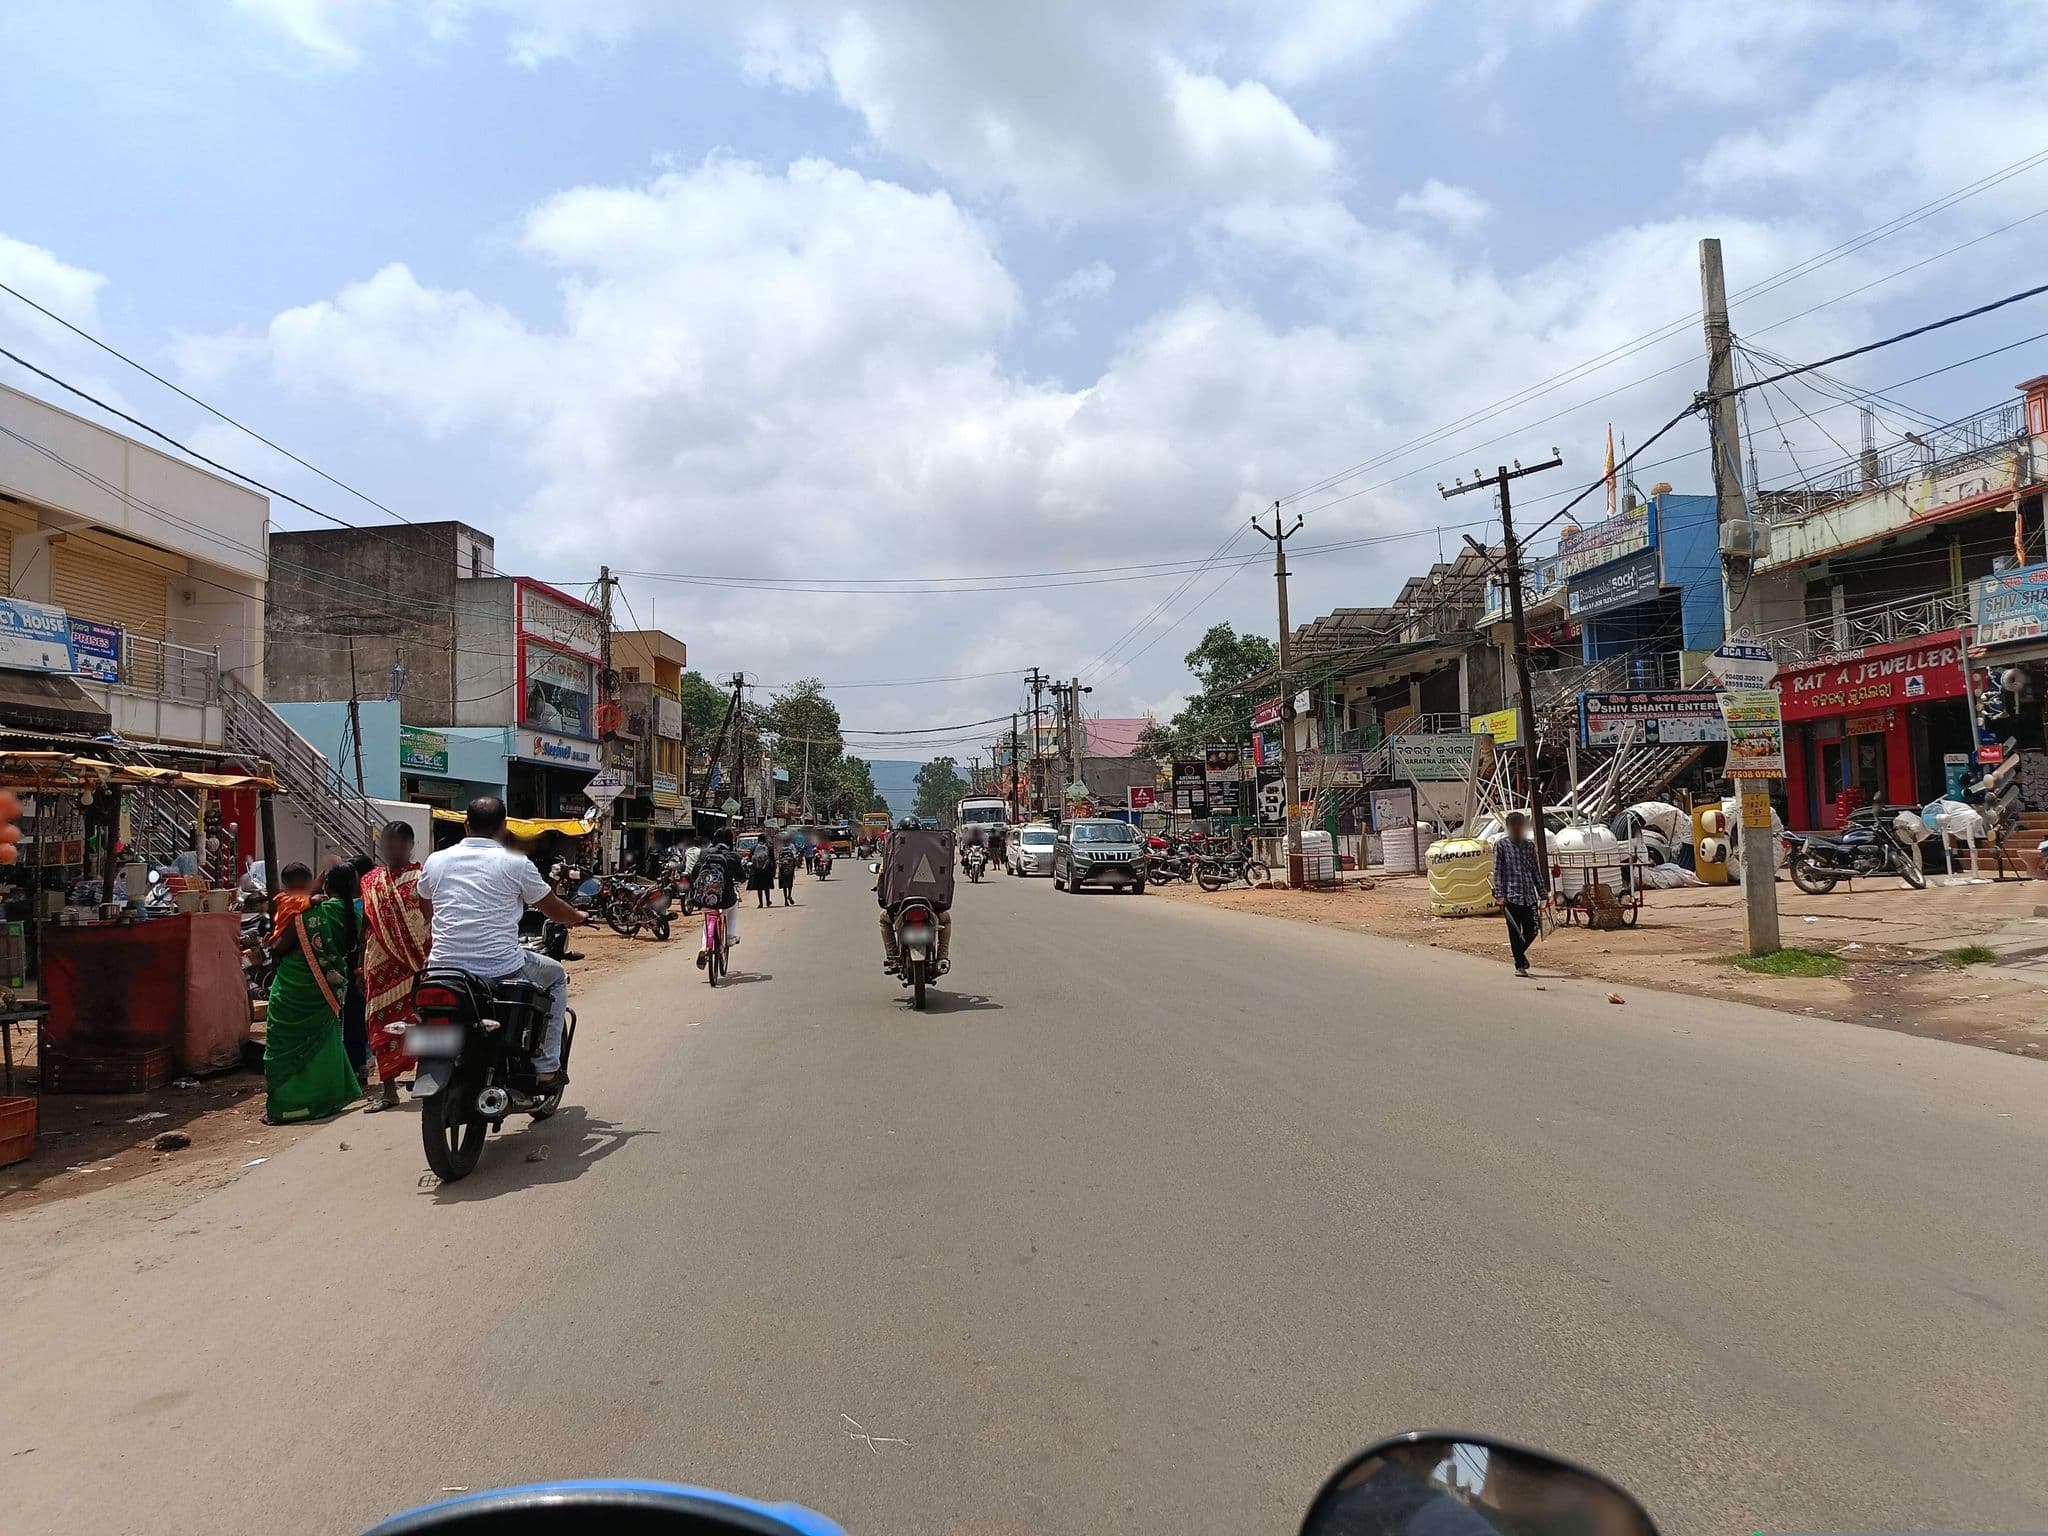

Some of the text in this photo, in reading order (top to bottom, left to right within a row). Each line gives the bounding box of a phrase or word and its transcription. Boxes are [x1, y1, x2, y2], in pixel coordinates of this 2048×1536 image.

[1985, 593, 2017, 613] SHIV
[22, 613, 65, 633] HOUSE
[1722, 647, 1742, 657] BCA
[1794, 672, 1827, 692] RAT
[1837, 670, 1849, 685] A
[1601, 705, 1628, 713] SHIV
[1632, 704, 1674, 713] SHAKTI
